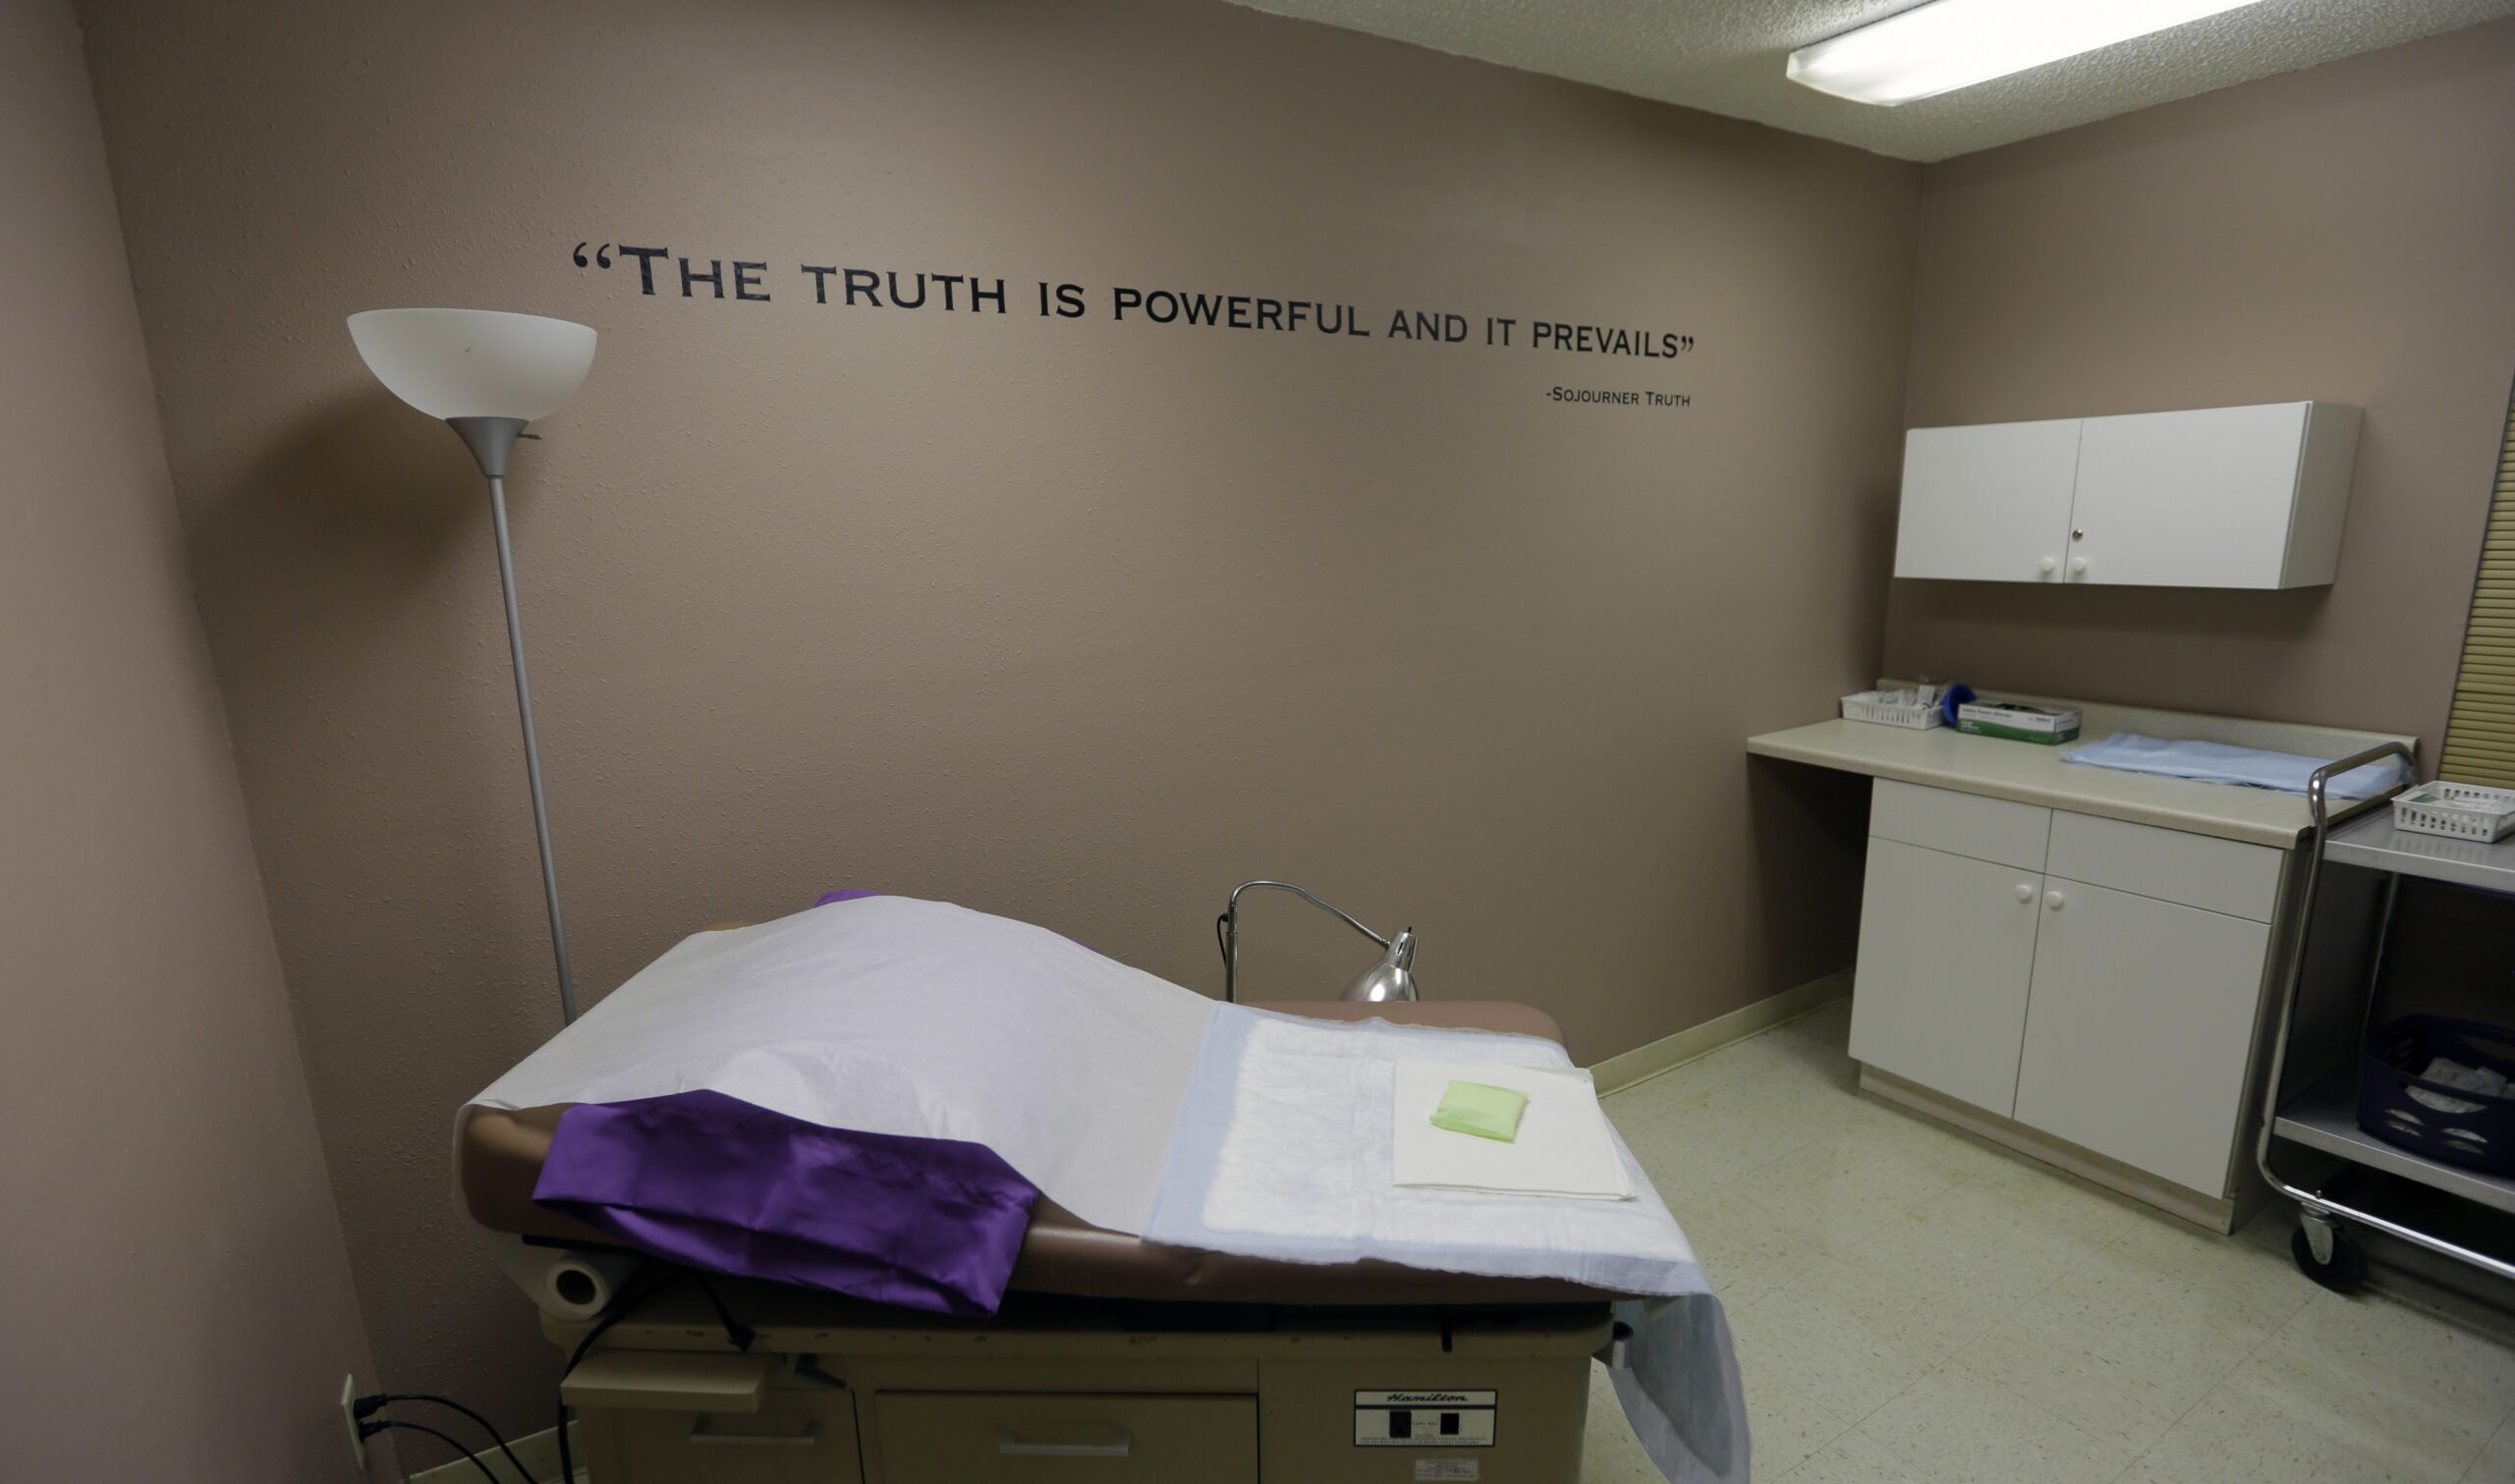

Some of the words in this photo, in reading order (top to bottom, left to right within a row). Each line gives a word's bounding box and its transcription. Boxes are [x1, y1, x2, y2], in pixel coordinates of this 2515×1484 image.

[800, 263, 1007, 314] TRUTH
[1037, 281, 1086, 318] IS
[1112, 287, 1370, 338] POWERFUL
[1387, 309, 1468, 343] AND
[1486, 317, 1517, 347] IT
[1645, 391, 1691, 408] TRUTH
[1386, 1393, 1468, 1402] Hamilton
